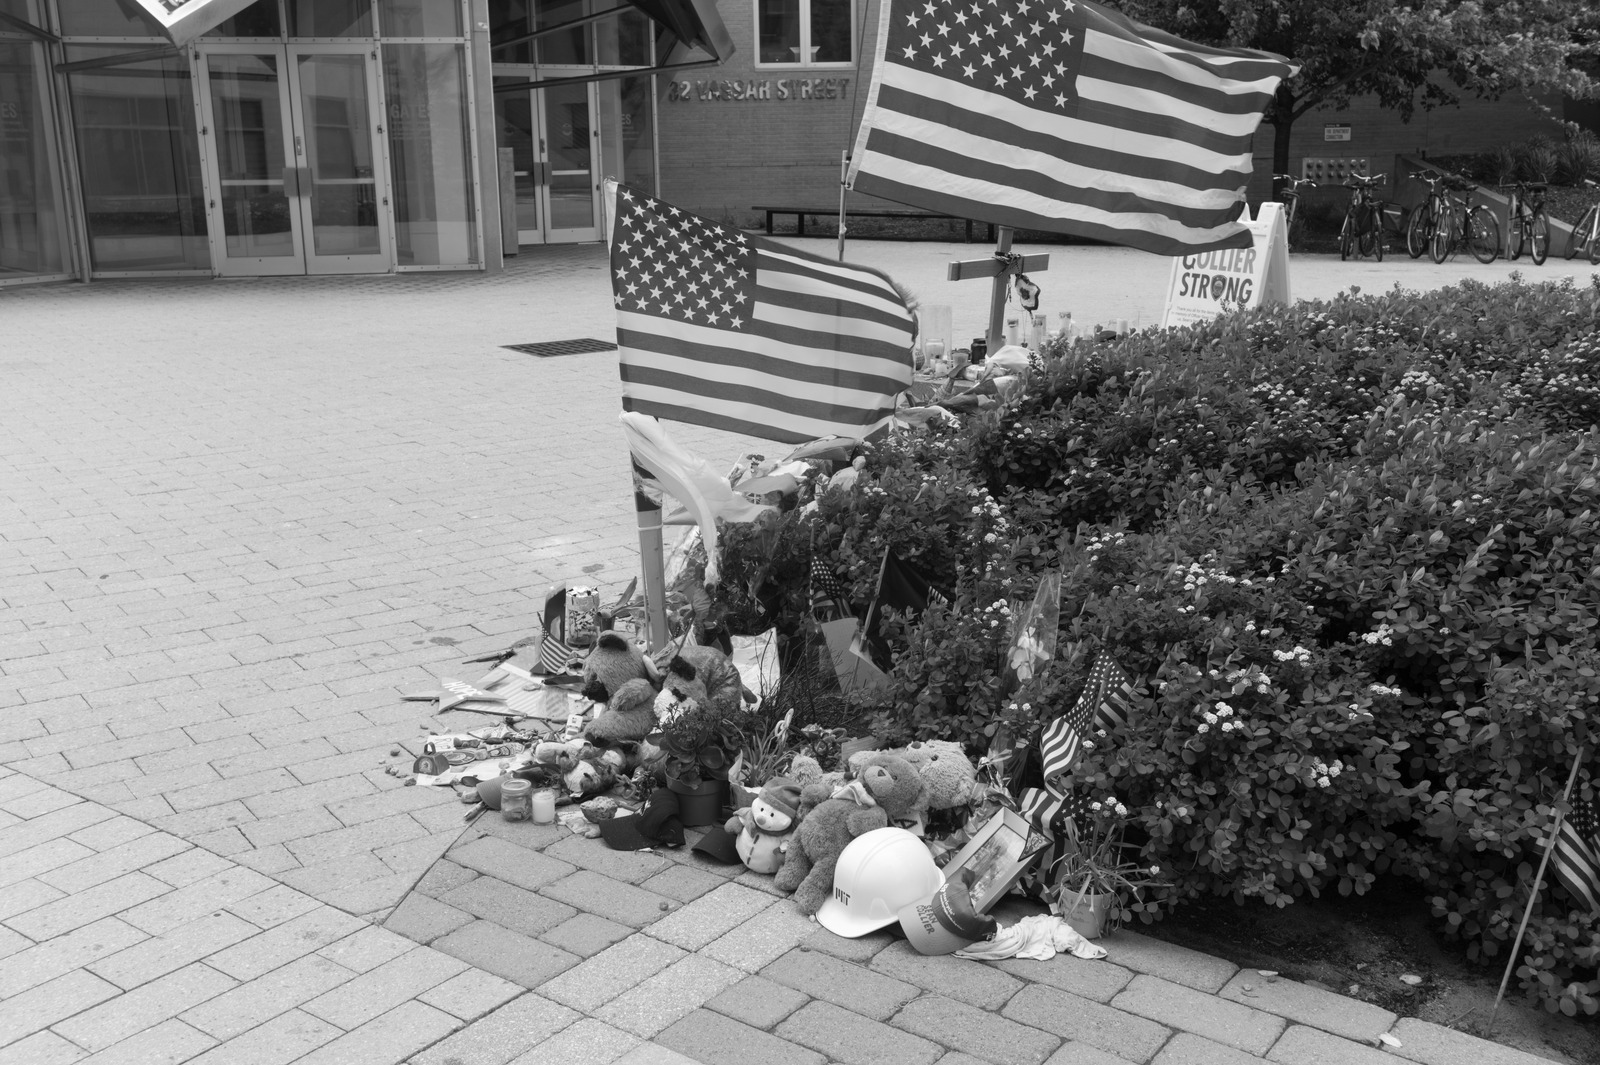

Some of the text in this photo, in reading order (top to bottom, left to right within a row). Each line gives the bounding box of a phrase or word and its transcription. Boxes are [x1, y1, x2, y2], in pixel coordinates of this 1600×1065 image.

[696, 79, 771, 101] VASSAR
[777, 78, 850, 100] STREET
[1182, 248, 1257, 274] COLLIER
[1179, 272, 1254, 304] STRONG
[835, 886, 851, 906] MIT
[915, 904, 936, 935] COLLIER
[923, 904, 939, 924] SEAN
